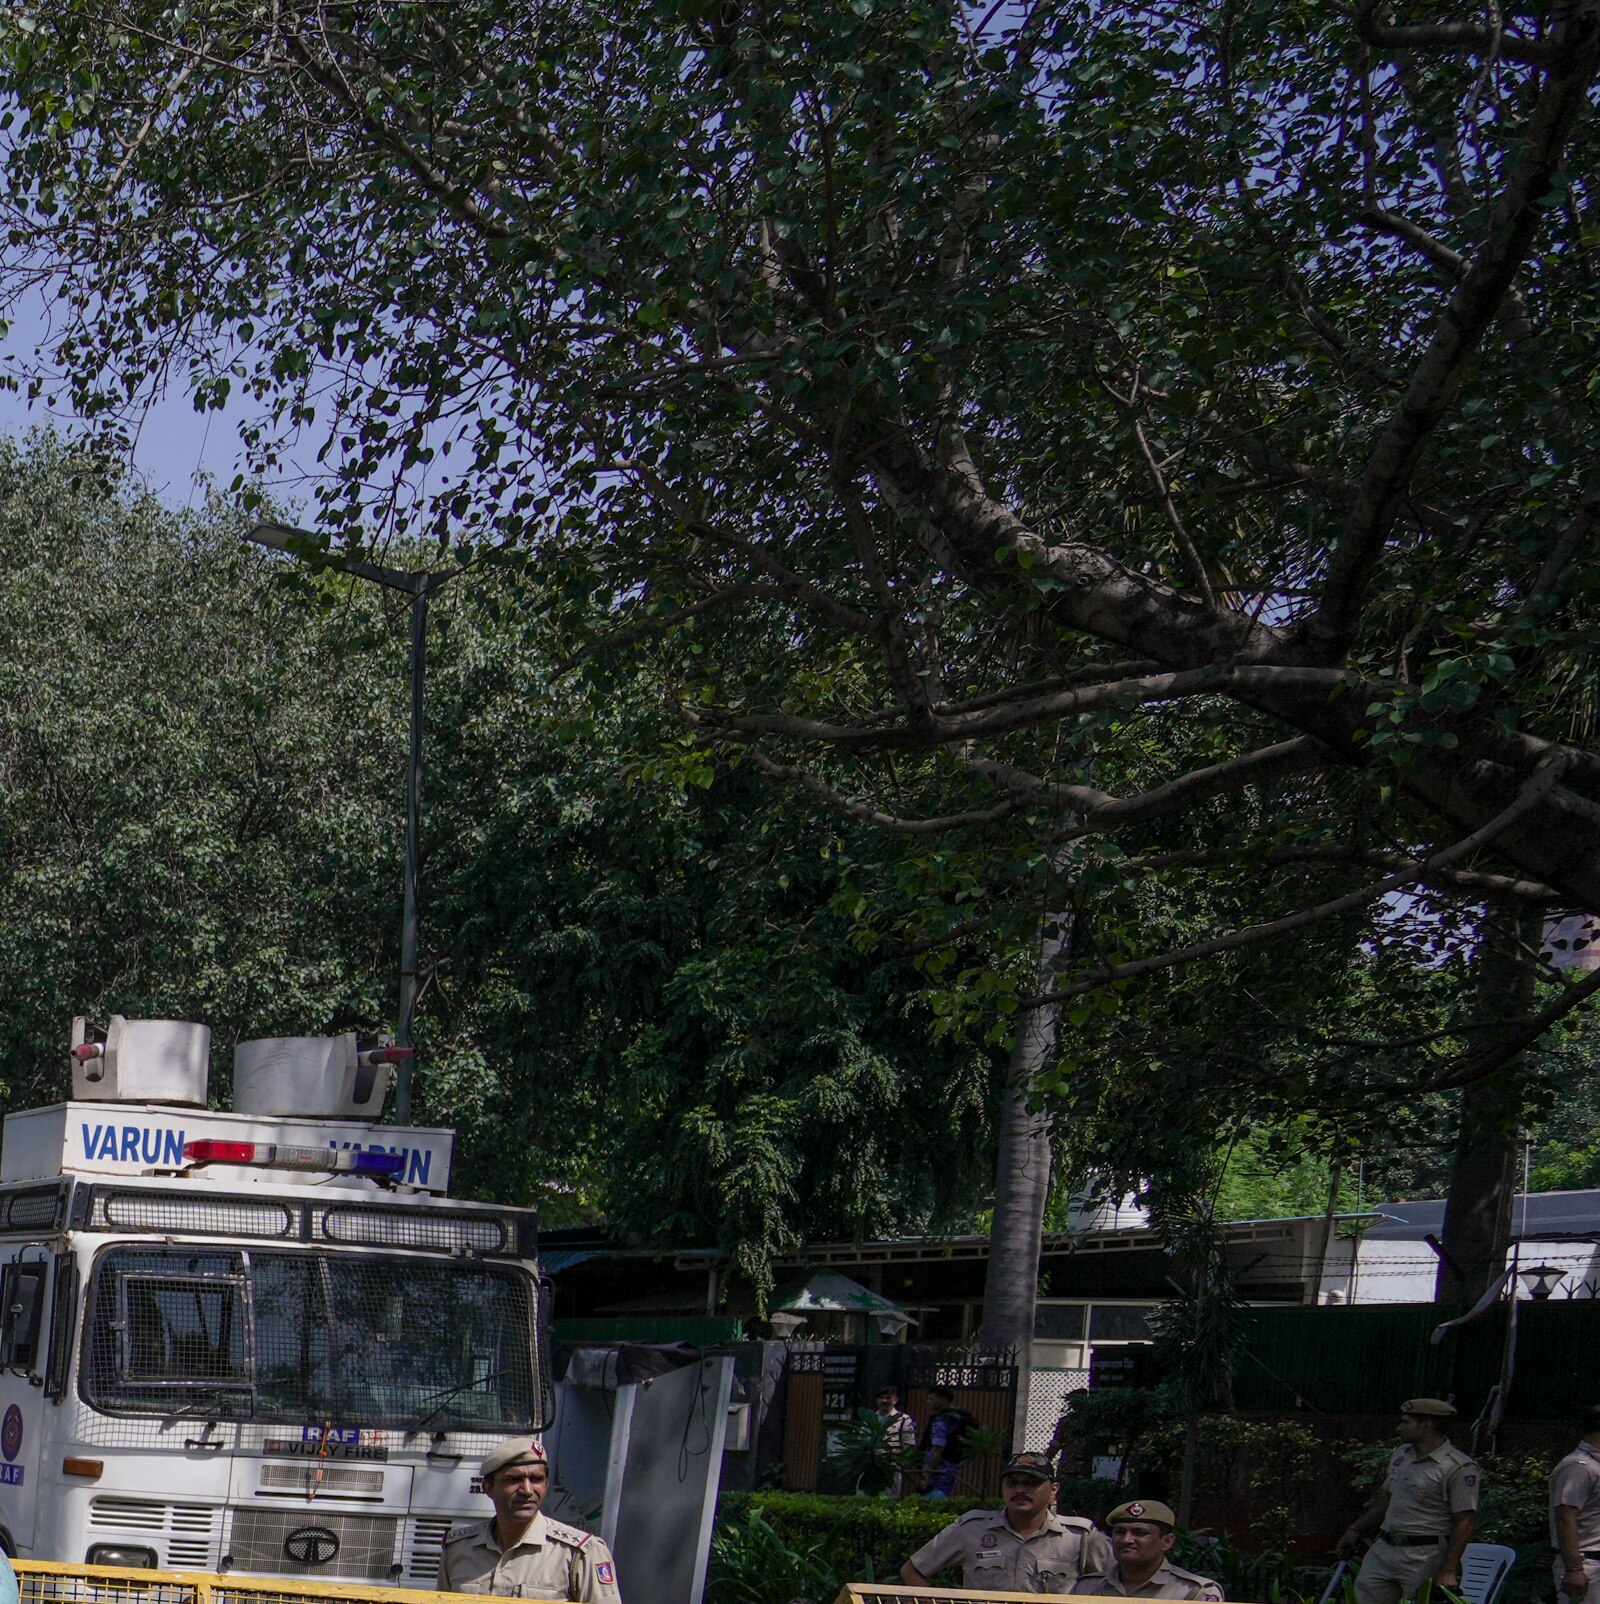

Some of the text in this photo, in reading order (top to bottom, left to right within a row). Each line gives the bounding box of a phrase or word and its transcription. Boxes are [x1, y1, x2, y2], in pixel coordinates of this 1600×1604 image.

[82, 1124, 185, 1165] VARUN
[308, 1427, 357, 1442] RAF
[288, 1442, 341, 1457] VIJAY
[345, 1446, 385, 1460] FIRE
